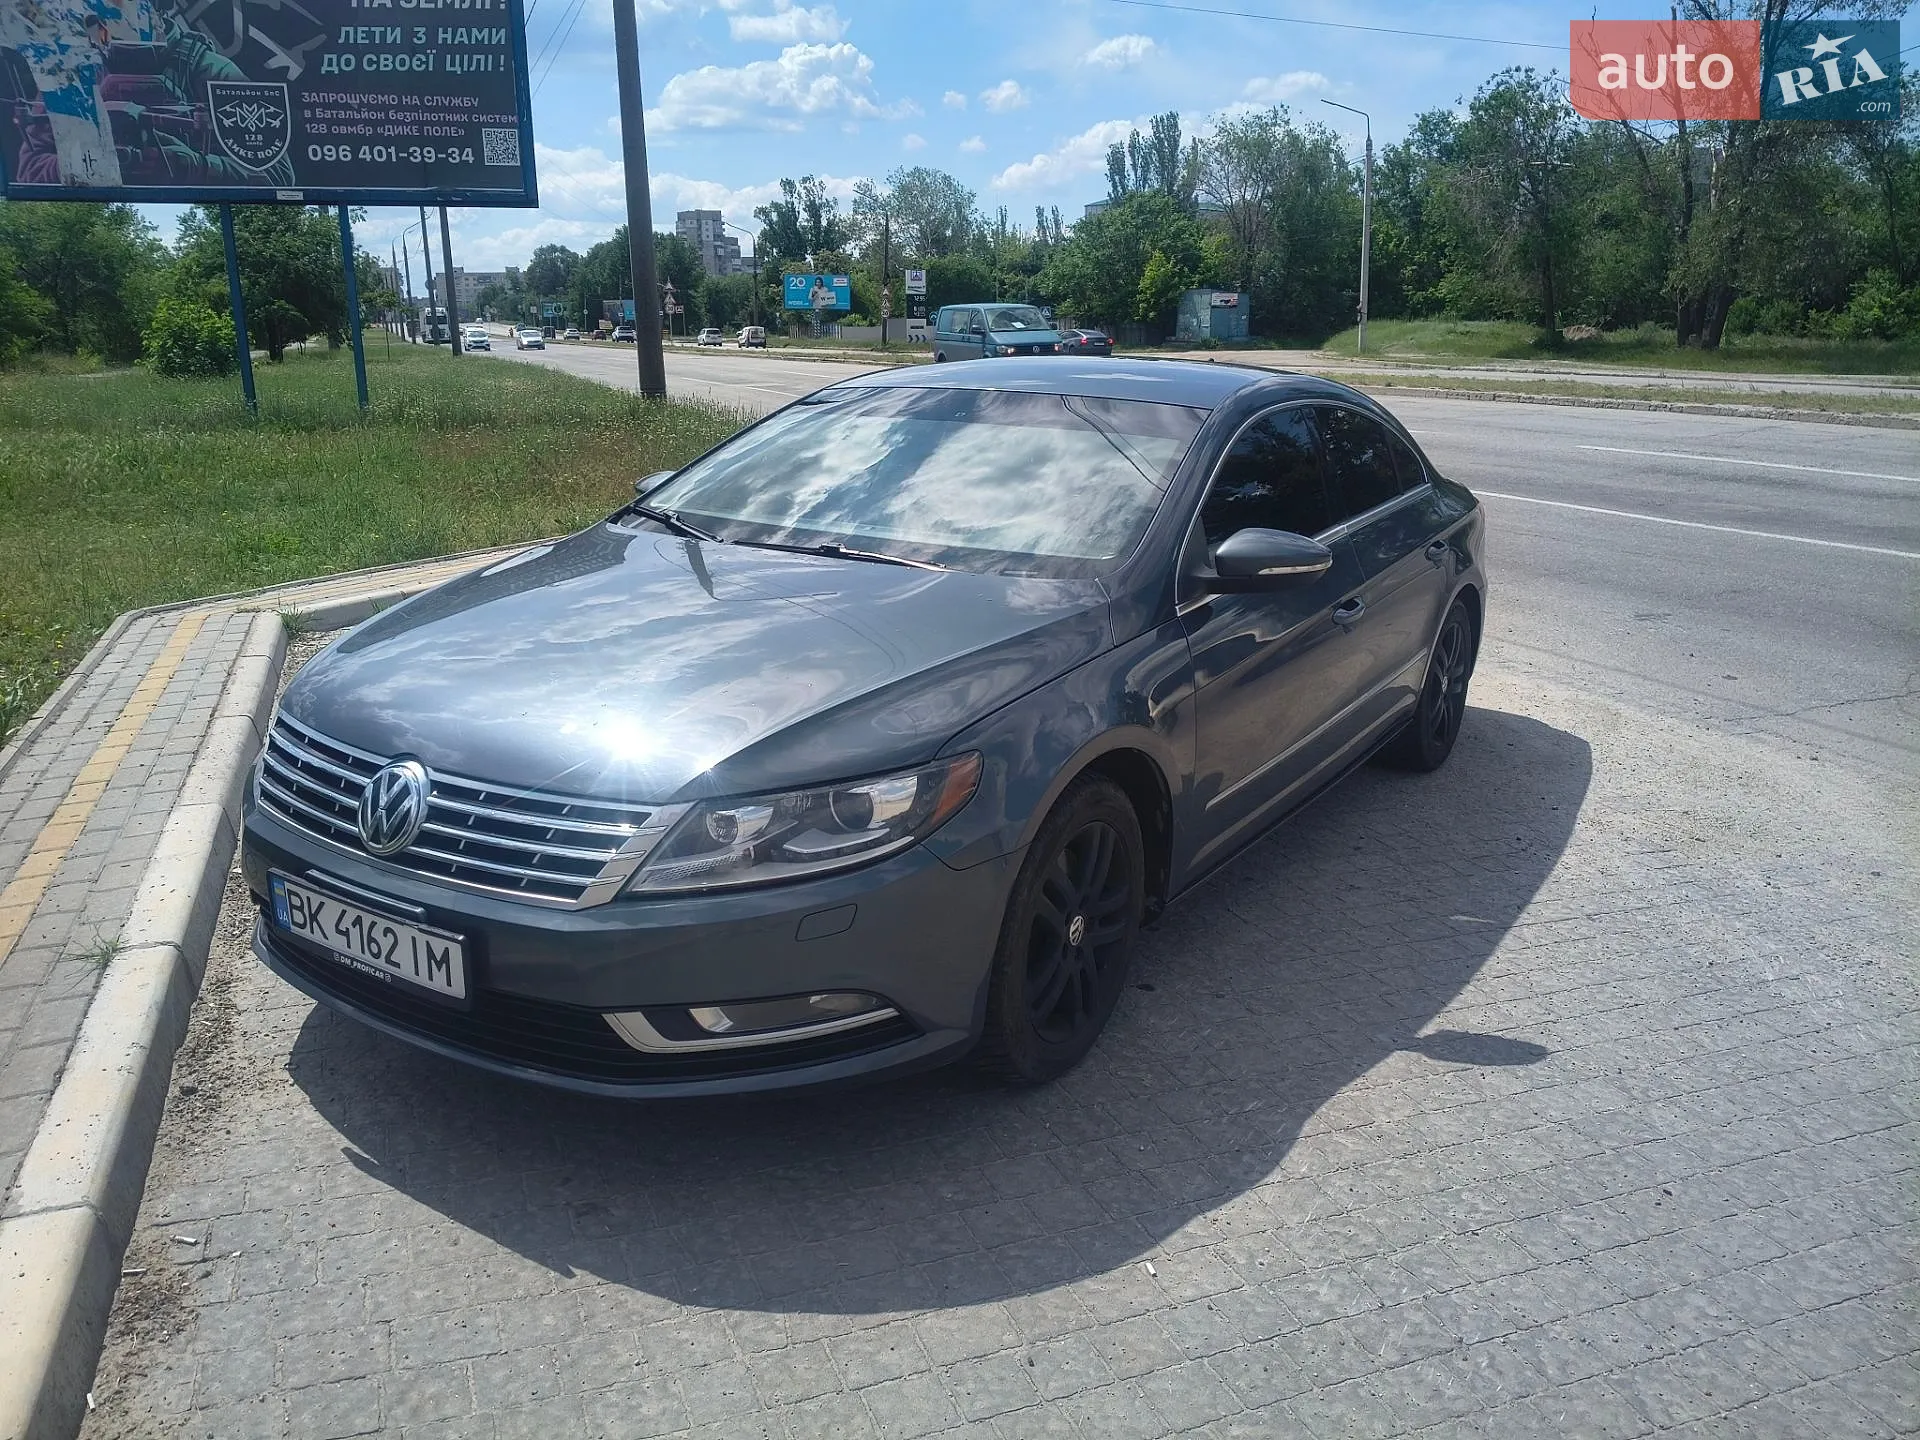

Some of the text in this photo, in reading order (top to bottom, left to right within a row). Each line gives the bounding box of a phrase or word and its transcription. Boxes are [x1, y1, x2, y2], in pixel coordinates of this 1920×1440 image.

[338, 26, 401, 44] ЛЕТИ
[438, 27, 506, 45] НАМИ
[321, 54, 356, 74] ДО
[362, 49, 437, 72] СВОЄЇ
[301, 91, 479, 107] ЗАПРОШУЄМО НА СЛУЖБУ
[304, 107, 519, 124] в Батальйон безпілотних систем
[304, 123, 465, 137] 128 овмбр «ДИКЕ ПОЛЕ»
[307, 144, 475, 163] 096 401-39-34
[276, 909, 289, 923] UA
[286, 887, 452, 987] BK 4162 IM
